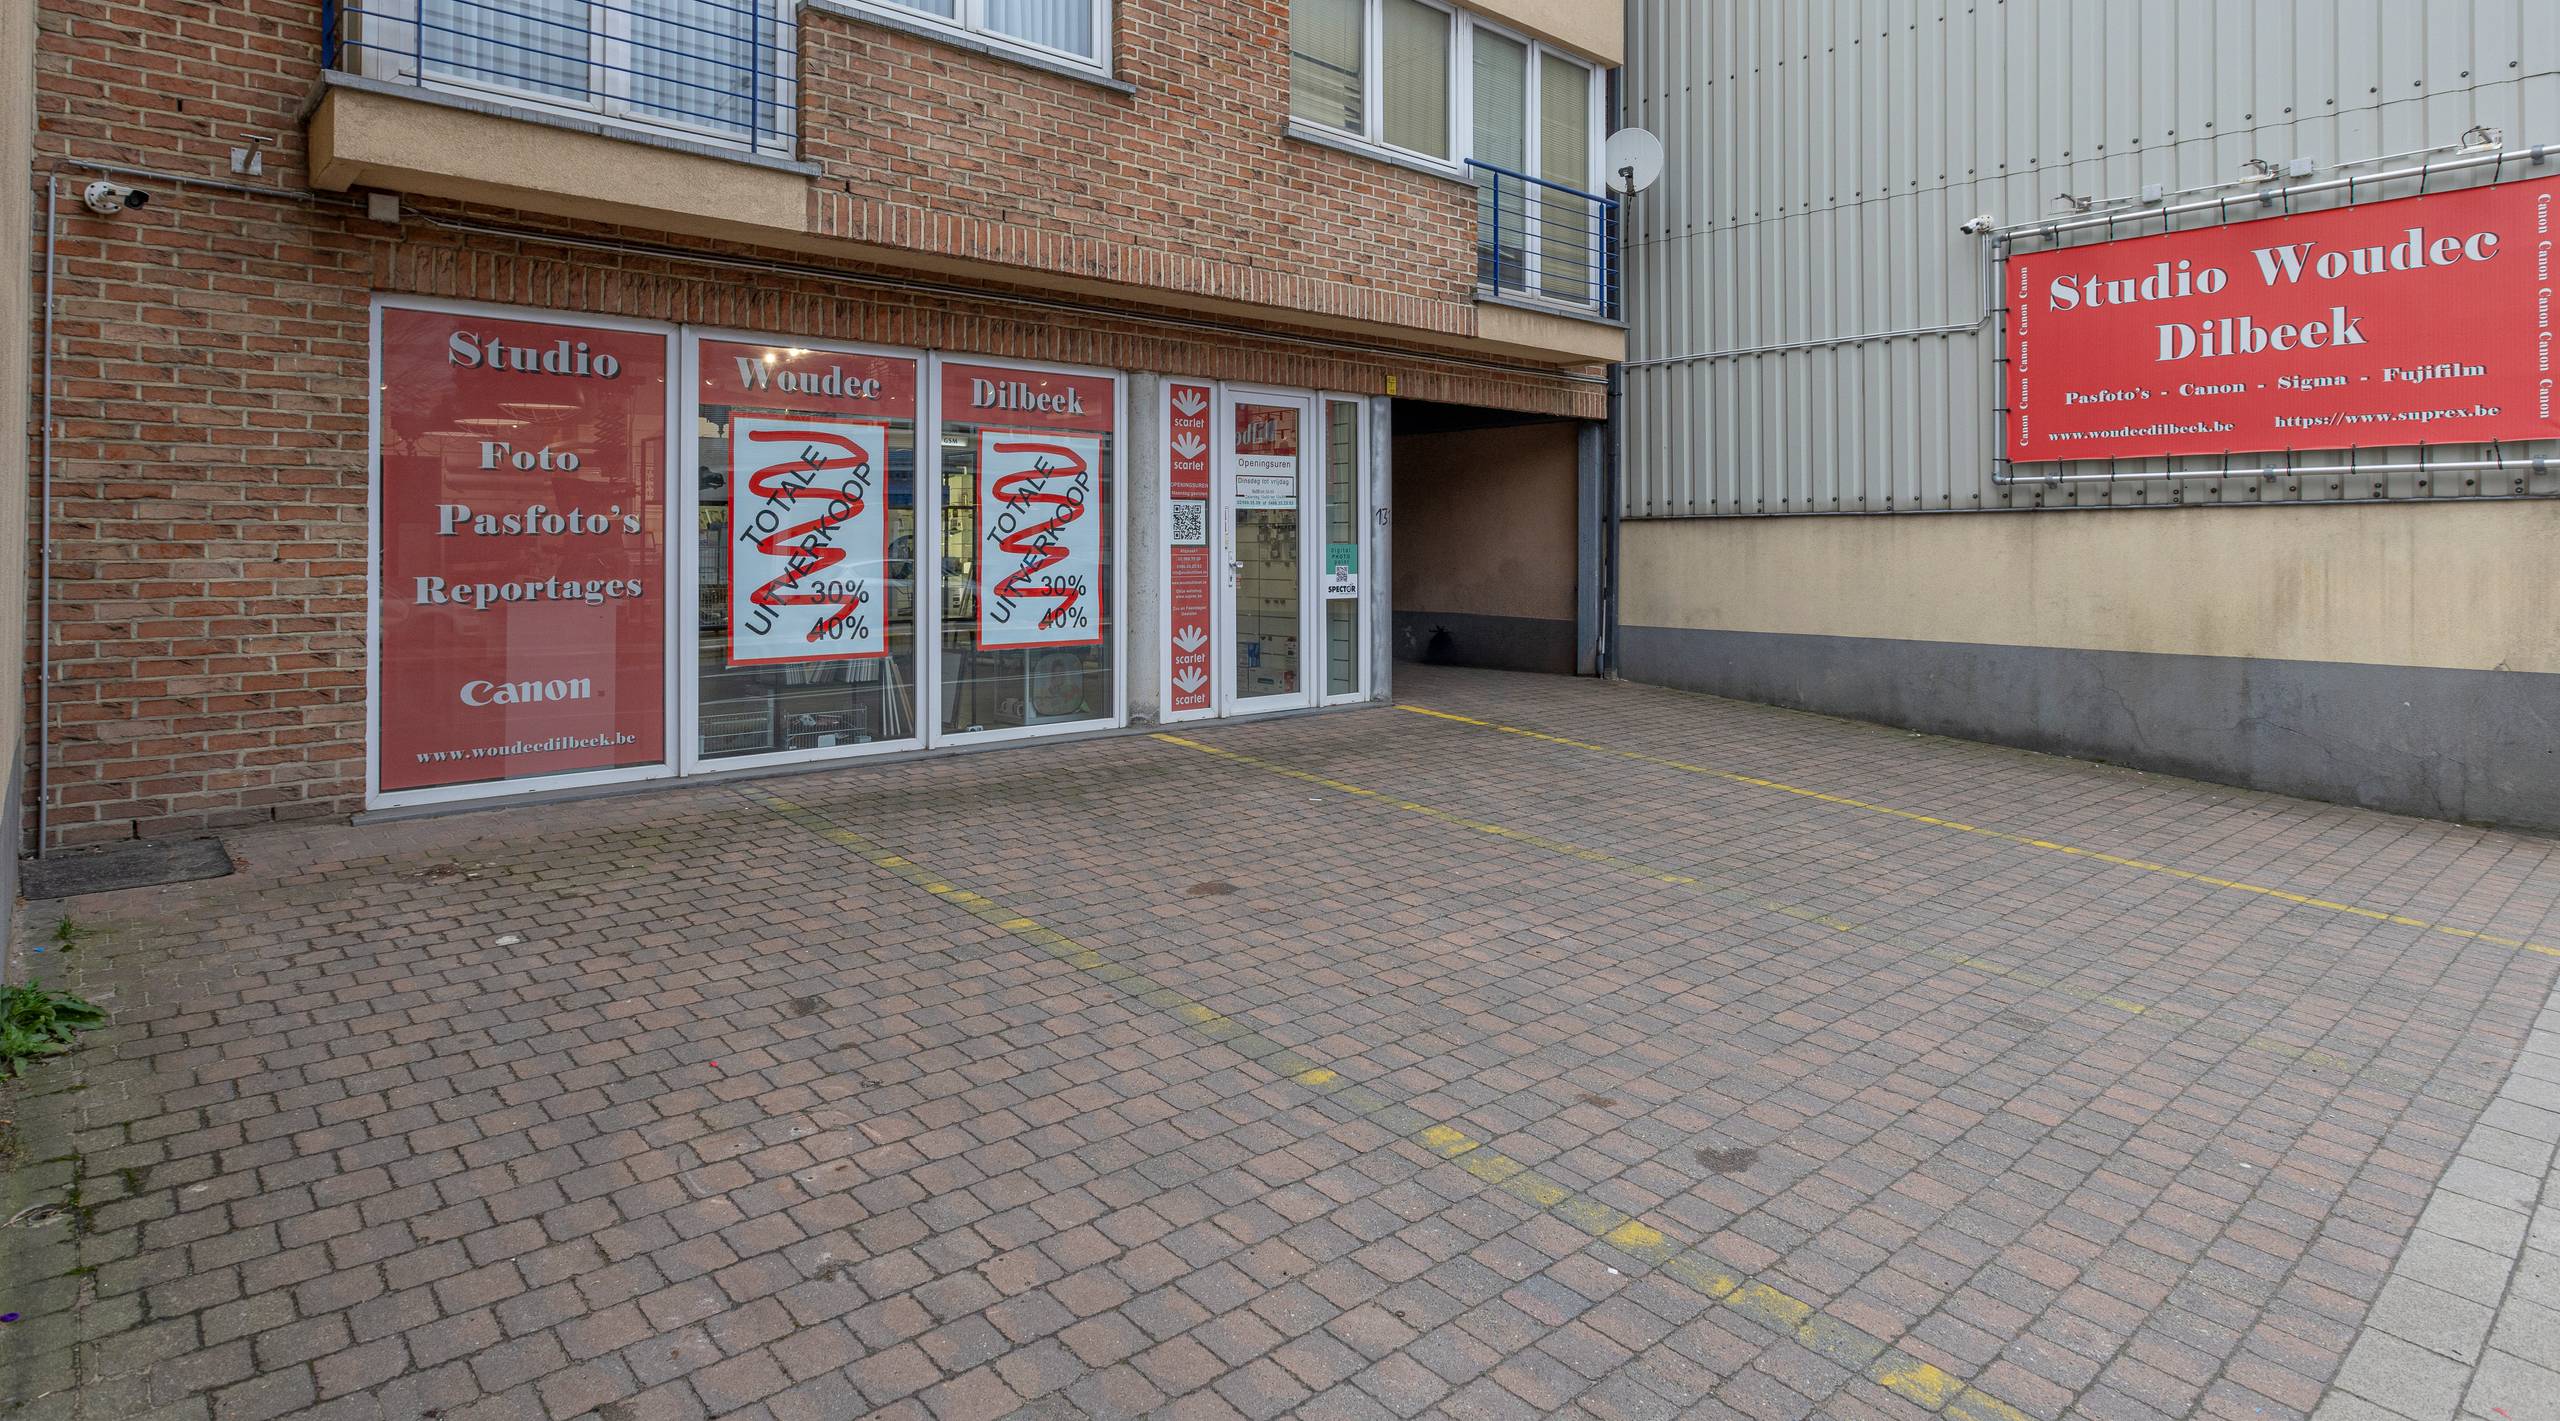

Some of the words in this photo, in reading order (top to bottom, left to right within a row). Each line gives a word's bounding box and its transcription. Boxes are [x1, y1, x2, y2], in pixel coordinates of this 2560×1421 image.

[2537, 193, 2552, 234] Canon
[2050, 259, 2229, 312] Studio
[2251, 227, 2501, 286] Woudec
[2538, 240, 2552, 281] Canon
[2018, 267, 2028, 299] Canon
[2018, 303, 2028, 336] Canon
[2538, 287, 2553, 328] Canon
[2155, 305, 2368, 362] Dilbeek
[2018, 340, 2028, 373] Canon
[2539, 331, 2553, 372] Canon
[449, 330, 621, 378] Studio
[736, 356, 881, 400] Woudec
[971, 377, 1085, 415] Dilbeek
[2065, 387, 2151, 405] Pasfoto's
[2179, 382, 2246, 397] Canon
[2278, 374, 2348, 391] Sigma
[2382, 362, 2487, 384] Fujifilm
[2018, 378, 2029, 410] Canon
[2539, 378, 2553, 419] Canon
[1175, 418, 1204, 428] scarlet
[2019, 415, 2029, 447] Canon
[2048, 421, 2236, 441] www.woudecdilbeek.be
[2274, 404, 2501, 429] https://www.suprex.be
[479, 441, 580, 472] Foto
[1174, 461, 1204, 470] scarlet
[1238, 458, 1291, 469] Openingsuren
[739, 444, 828, 547] TOTALE
[987, 455, 1054, 549] TOTALE
[436, 504, 641, 537] Pasfoto's
[745, 462, 871, 636] UITVERKOOP
[990, 471, 1090, 624] UITVERKOOP
[414, 575, 643, 610] Reportages
[811, 579, 869, 604] 30%
[1041, 575, 1086, 597] 30%
[1328, 584, 1356, 593] SPECTOR
[810, 615, 869, 641] 40%
[1040, 607, 1088, 629] 40%
[1176, 653, 1205, 664] scarlet
[460, 676, 591, 707] Canon
[1176, 694, 1205, 705] scarlet
[416, 731, 636, 764] www.woudecdilbeek.be
